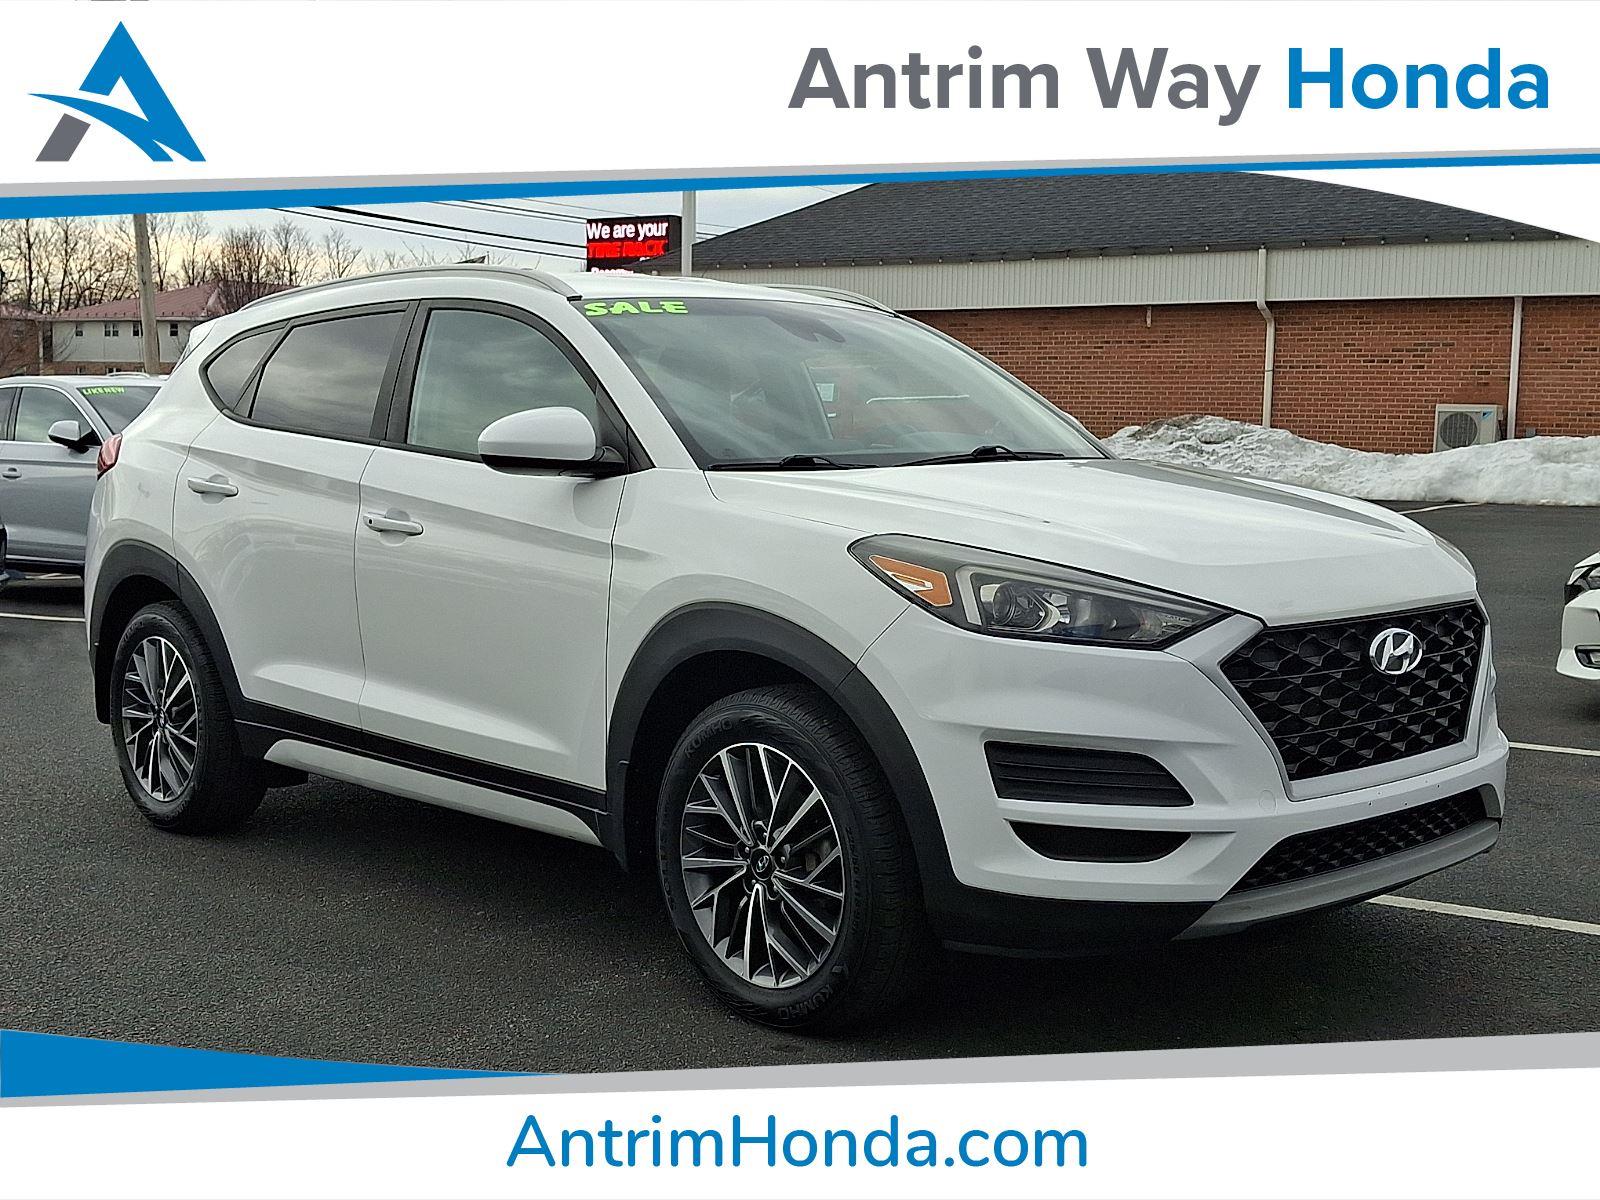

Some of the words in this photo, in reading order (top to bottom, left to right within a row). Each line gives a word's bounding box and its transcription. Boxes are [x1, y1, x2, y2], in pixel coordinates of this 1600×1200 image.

[586, 222, 611, 240] We
[612, 224, 636, 239] are
[637, 222, 668, 241] your
[584, 301, 689, 316] SALE
[82, 387, 104, 395] LIKE
